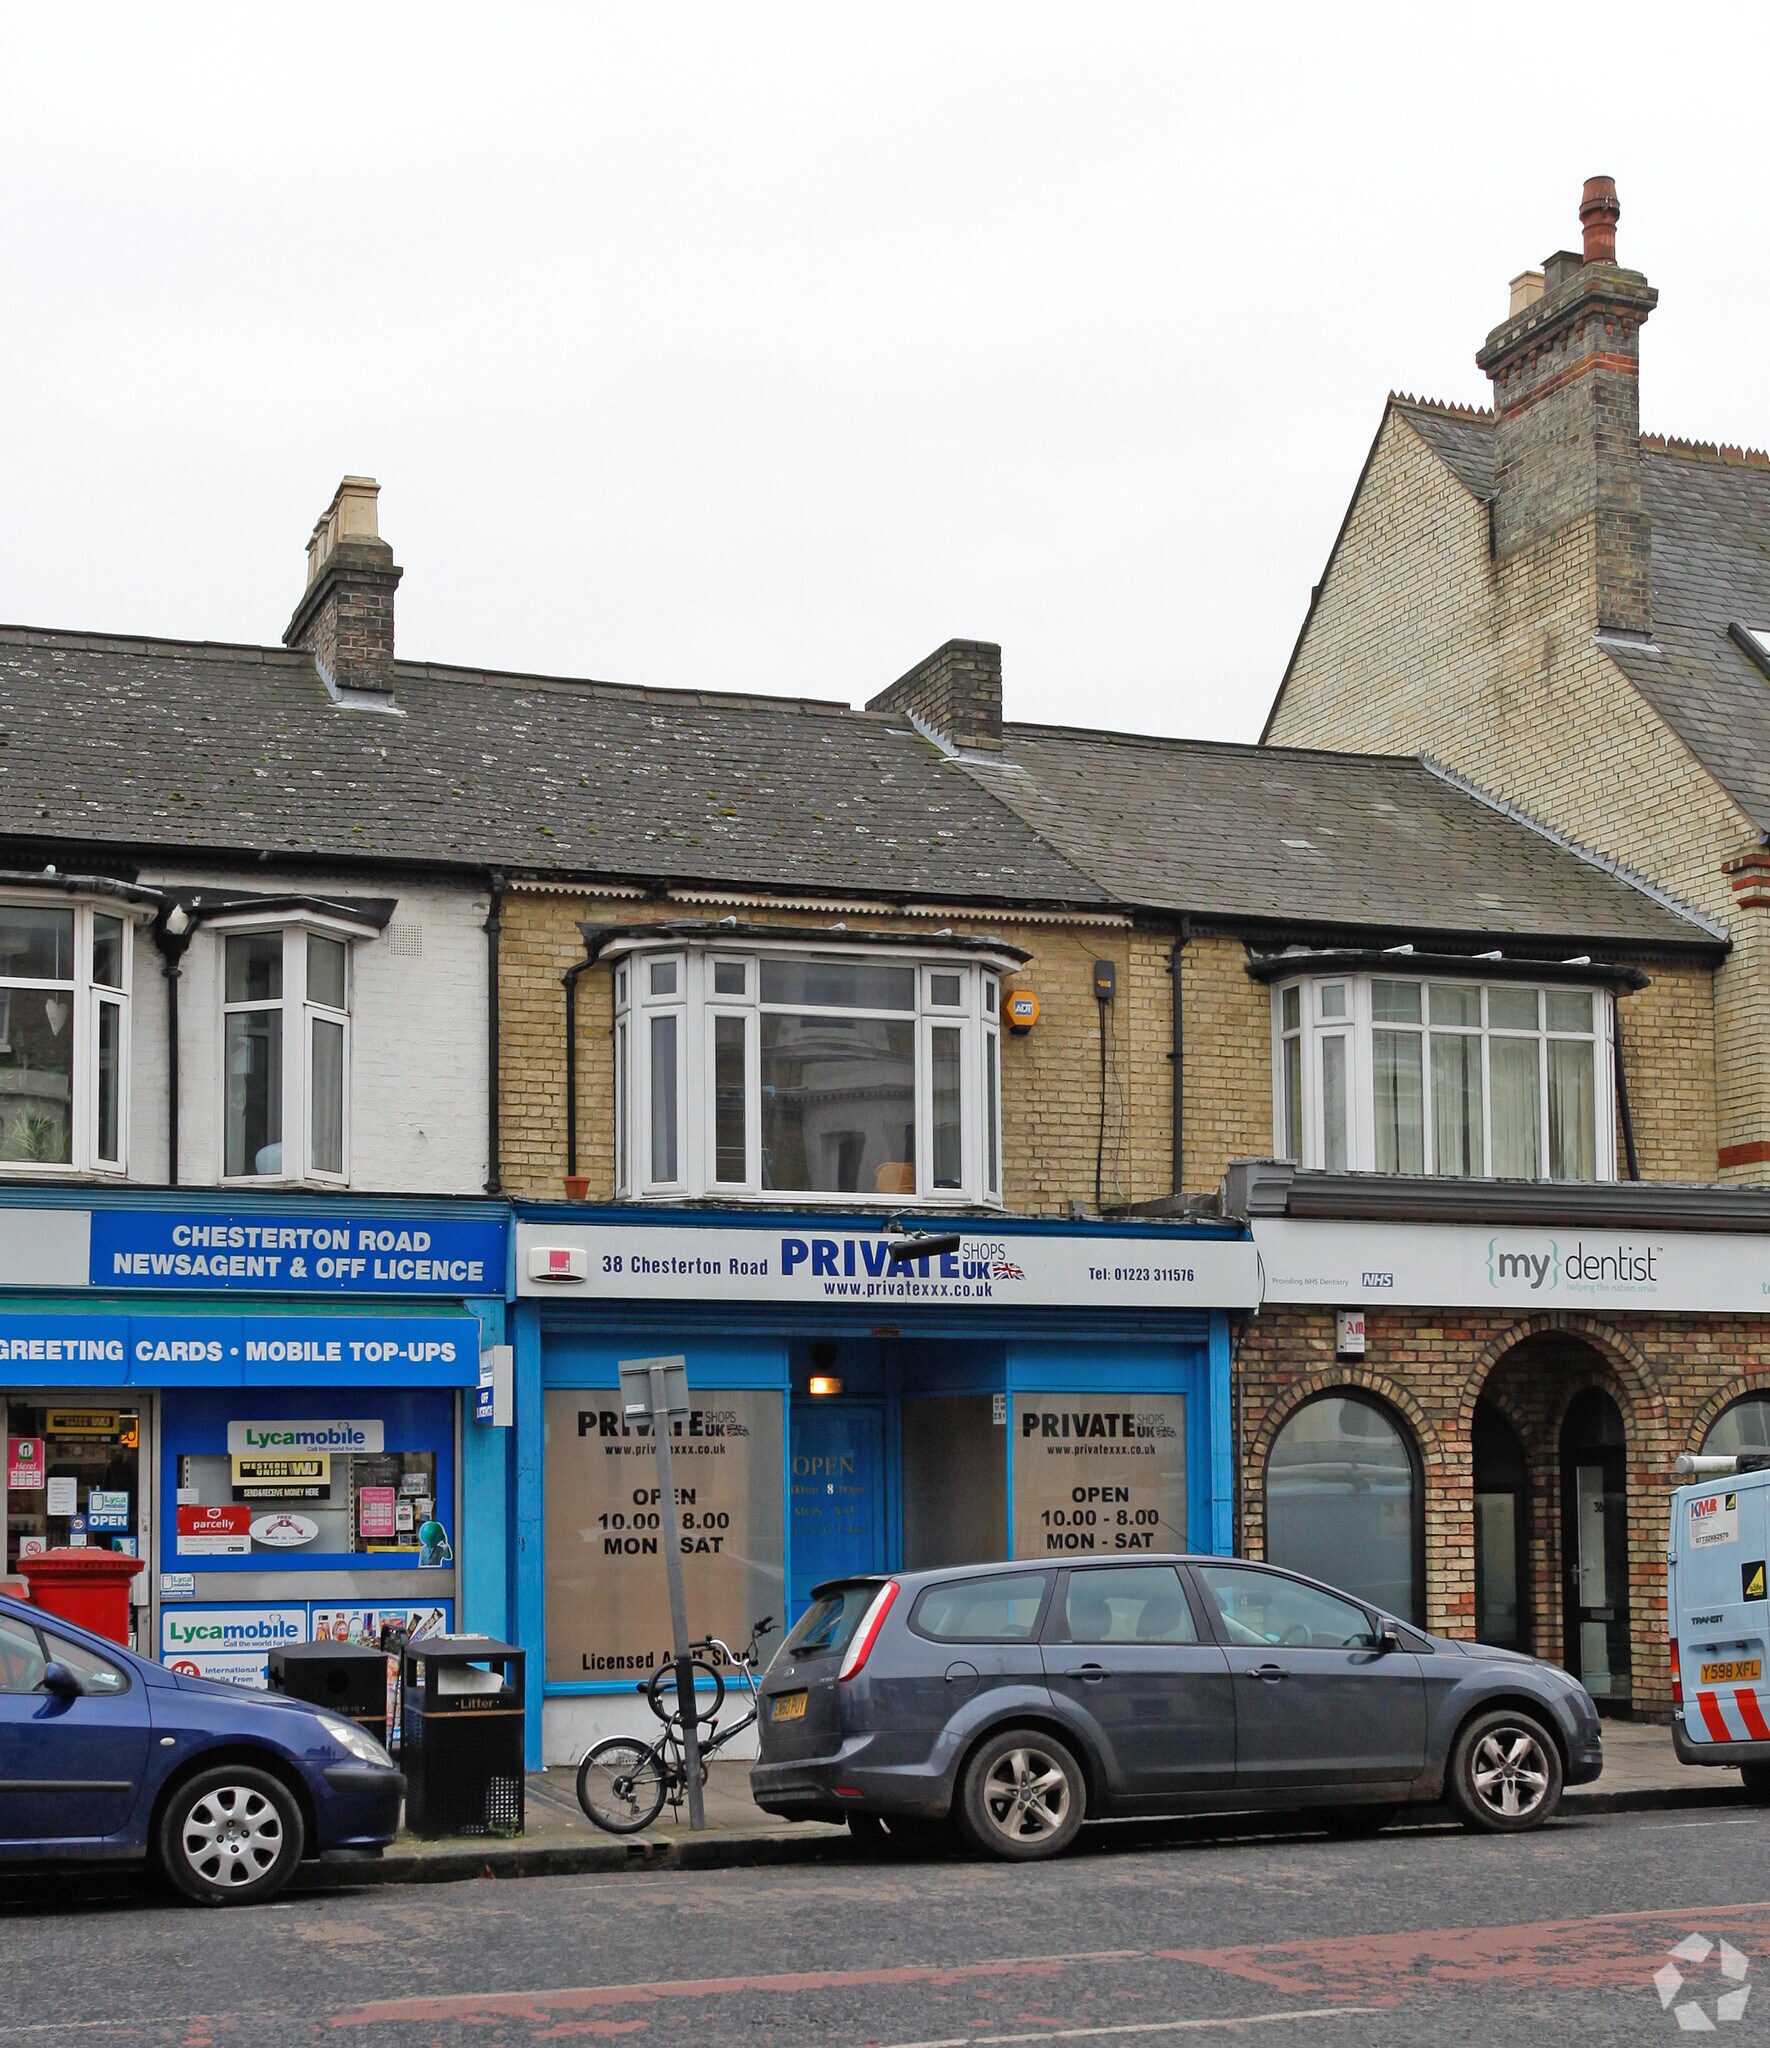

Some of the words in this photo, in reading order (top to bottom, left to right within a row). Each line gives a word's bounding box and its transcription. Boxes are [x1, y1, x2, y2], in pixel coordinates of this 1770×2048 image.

[1015, 1003, 1033, 1013] ADT
[172, 1225, 350, 1250] CHESTERTON
[359, 1230, 431, 1252] ROAD
[963, 1242, 1006, 1261] SHOPS
[113, 1253, 282, 1278] NEWSAGENT
[290, 1257, 308, 1279] &
[315, 1257, 365, 1279] OFF
[373, 1259, 484, 1282] LICENCE
[602, 1256, 623, 1273] 38
[631, 1256, 722, 1275] Chesterton
[730, 1258, 768, 1275] Road
[1565, 1242, 1657, 1282] dentist
[963, 1261, 991, 1279] UK
[1089, 1267, 1111, 1281] Tel:
[1114, 1267, 1149, 1282] 01223
[1154, 1268, 1194, 1282] 311576
[1272, 1277, 1303, 1286] Providing
[1304, 1278, 1319, 1286] NHS
[1320, 1279, 1349, 1287] Dentistry
[1362, 1273, 1392, 1287] NHS
[824, 1281, 993, 1298] www.privatexxx.co.uk
[1566, 1283, 1595, 1293] helping
[1597, 1283, 1610, 1292] the
[1611, 1284, 1636, 1293] nation
[1637, 1285, 1658, 1293] smile
[0, 1340, 124, 1361] GREETING
[135, 1341, 223, 1362] CARDS
[246, 1341, 342, 1362] MOBILE
[350, 1341, 457, 1363] TOP-UPS
[705, 1411, 737, 1424] SHOPS
[705, 1424, 725, 1437] UK
[1022, 1413, 1136, 1438] PRIVATE
[1136, 1413, 1165, 1426] SHOPS
[1136, 1426, 1155, 1438] UK
[246, 1428, 366, 1449] Lycamobile
[605, 1443, 726, 1456] www.privexxx.co.uk
[1047, 1443, 1156, 1456] www.privatexxx.co.uk
[14, 1462, 37, 1470] Here!
[242, 1462, 288, 1470] WESTERN
[293, 1462, 319, 1475] WU
[792, 1456, 855, 1477] OPEN
[284, 1487, 304, 1497] MONEY
[305, 1487, 319, 1497] HERE
[826, 1483, 834, 1495] 8
[1072, 1487, 1129, 1502] OPEN
[104, 1496, 127, 1507] Lyca
[1691, 1499, 1717, 1518] KMB
[89, 1515, 128, 1527] OPEN
[193, 1520, 234, 1530] parcelly
[598, 1513, 660, 1530] 10.00
[682, 1513, 730, 1530] 8.00
[1041, 1510, 1097, 1526] 10.00
[1116, 1510, 1160, 1526] 8.00
[604, 1538, 658, 1555] MON
[680, 1538, 724, 1554] SAT
[1046, 1534, 1095, 1550] MON
[1114, 1533, 1155, 1548] SAT
[173, 1576, 192, 1584] Lyca
[1691, 1614, 1724, 1625] TRANSIT
[170, 1621, 299, 1643] Lycamobile
[582, 1653, 654, 1670] Licensed
[1702, 1664, 1733, 1680] Y598
[1735, 1661, 1759, 1677] XFL
[460, 1699, 493, 1709] Litter
